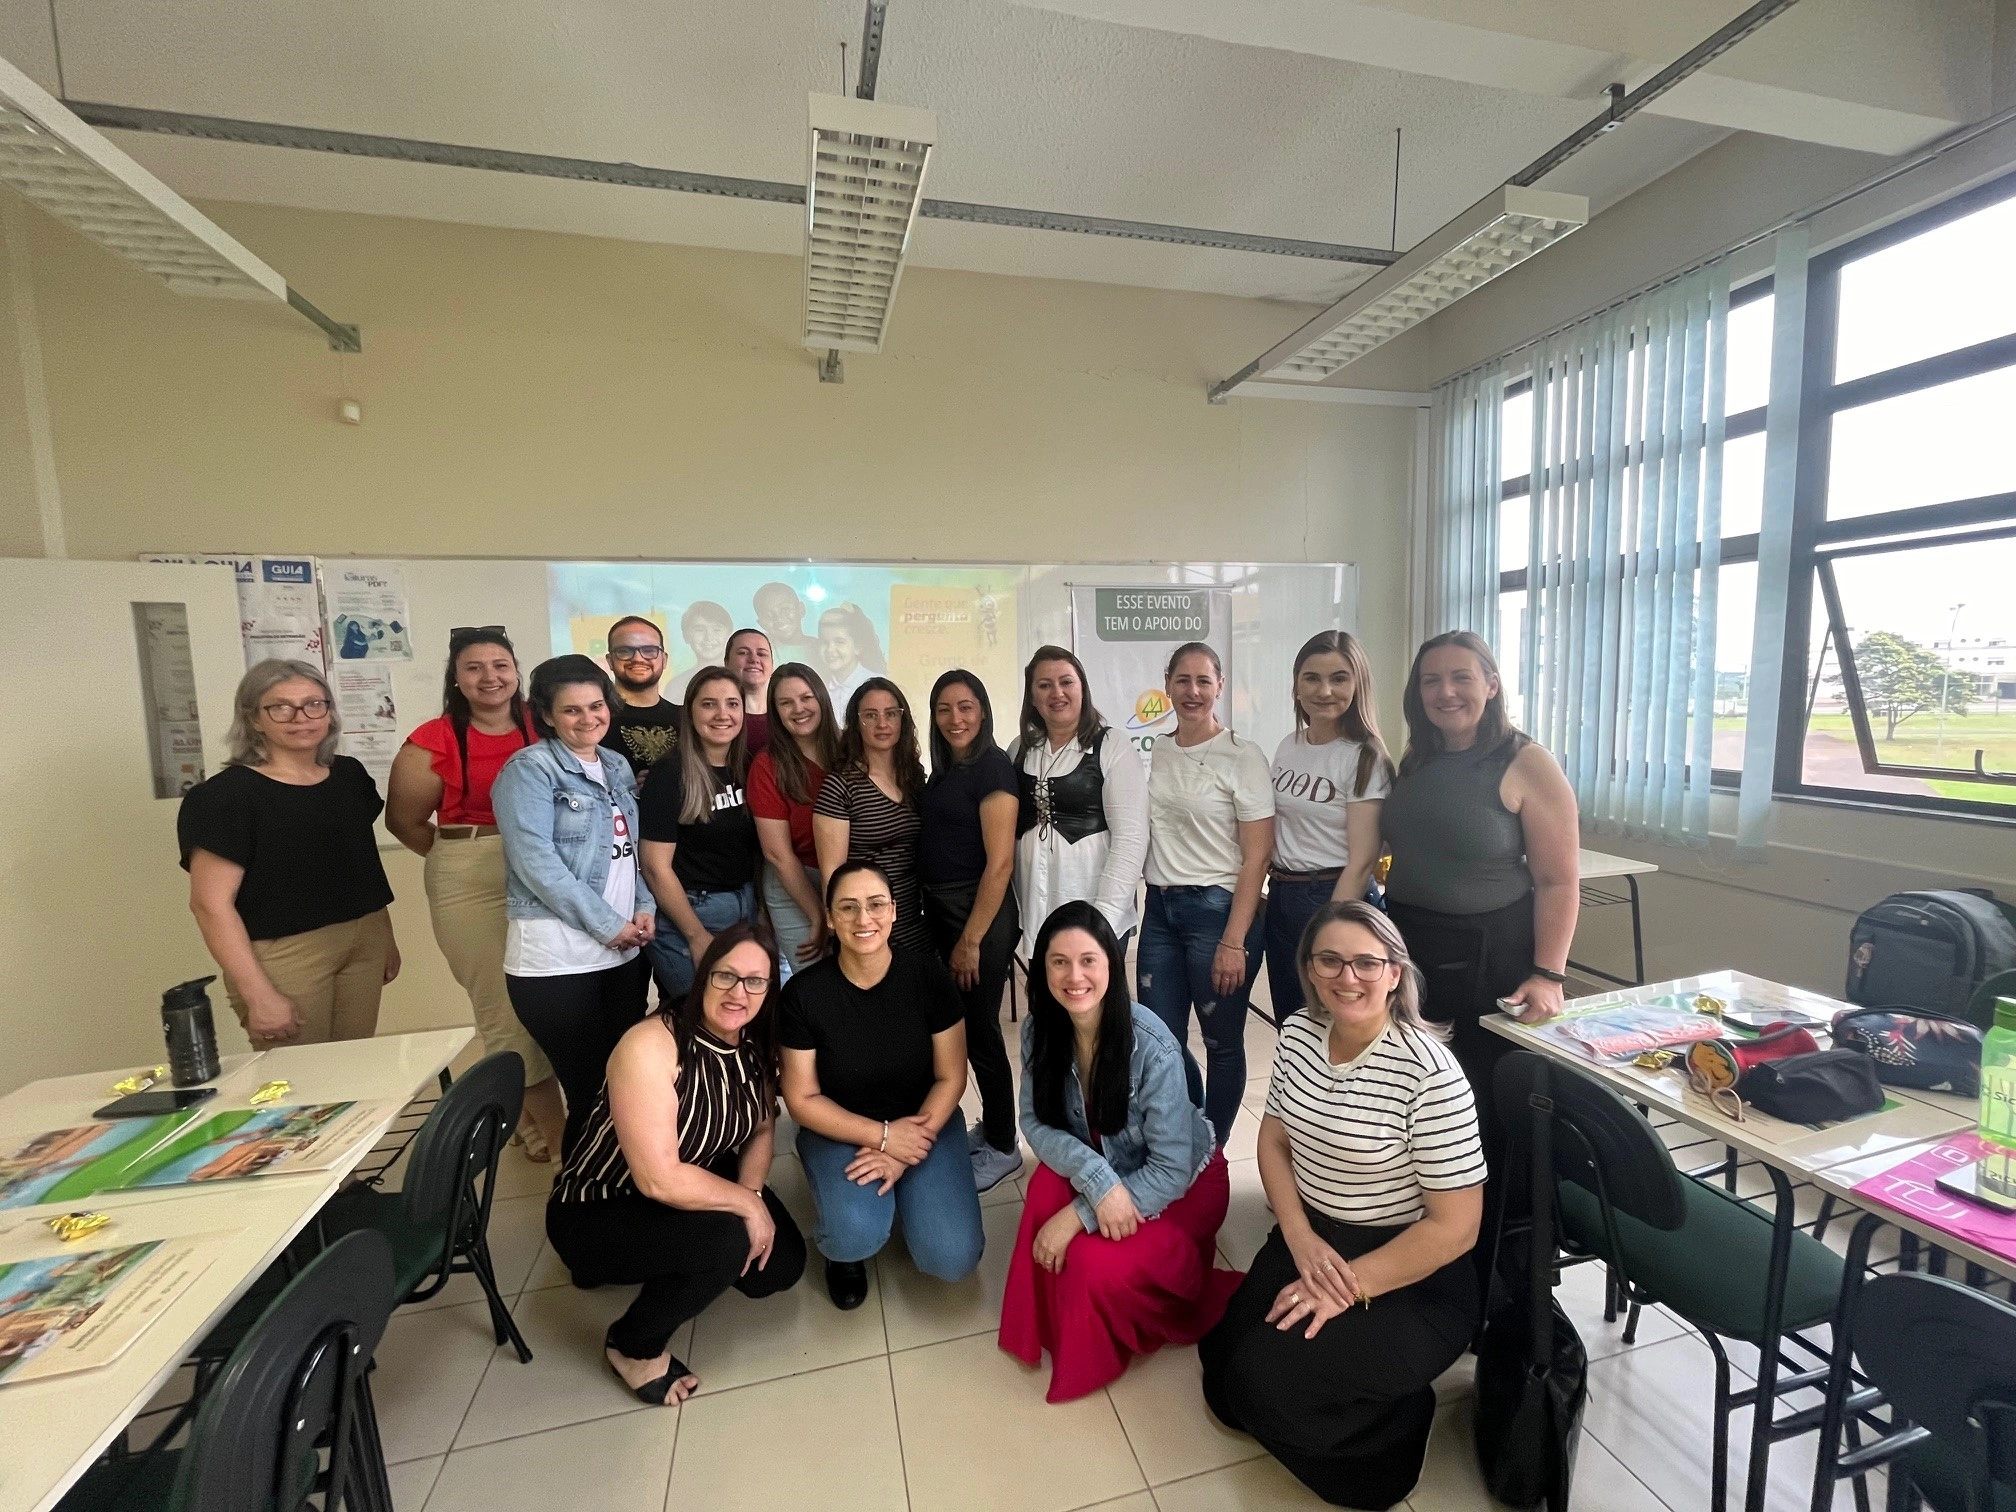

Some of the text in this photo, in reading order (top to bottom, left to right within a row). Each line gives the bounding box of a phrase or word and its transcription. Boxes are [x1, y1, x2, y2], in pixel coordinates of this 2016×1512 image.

[271, 565, 303, 575] GUIA
[1116, 594, 1191, 610] ESSE EVENTO
[1104, 616, 1202, 631] TEM O APOIO DO
[1272, 766, 1336, 803] OOD
